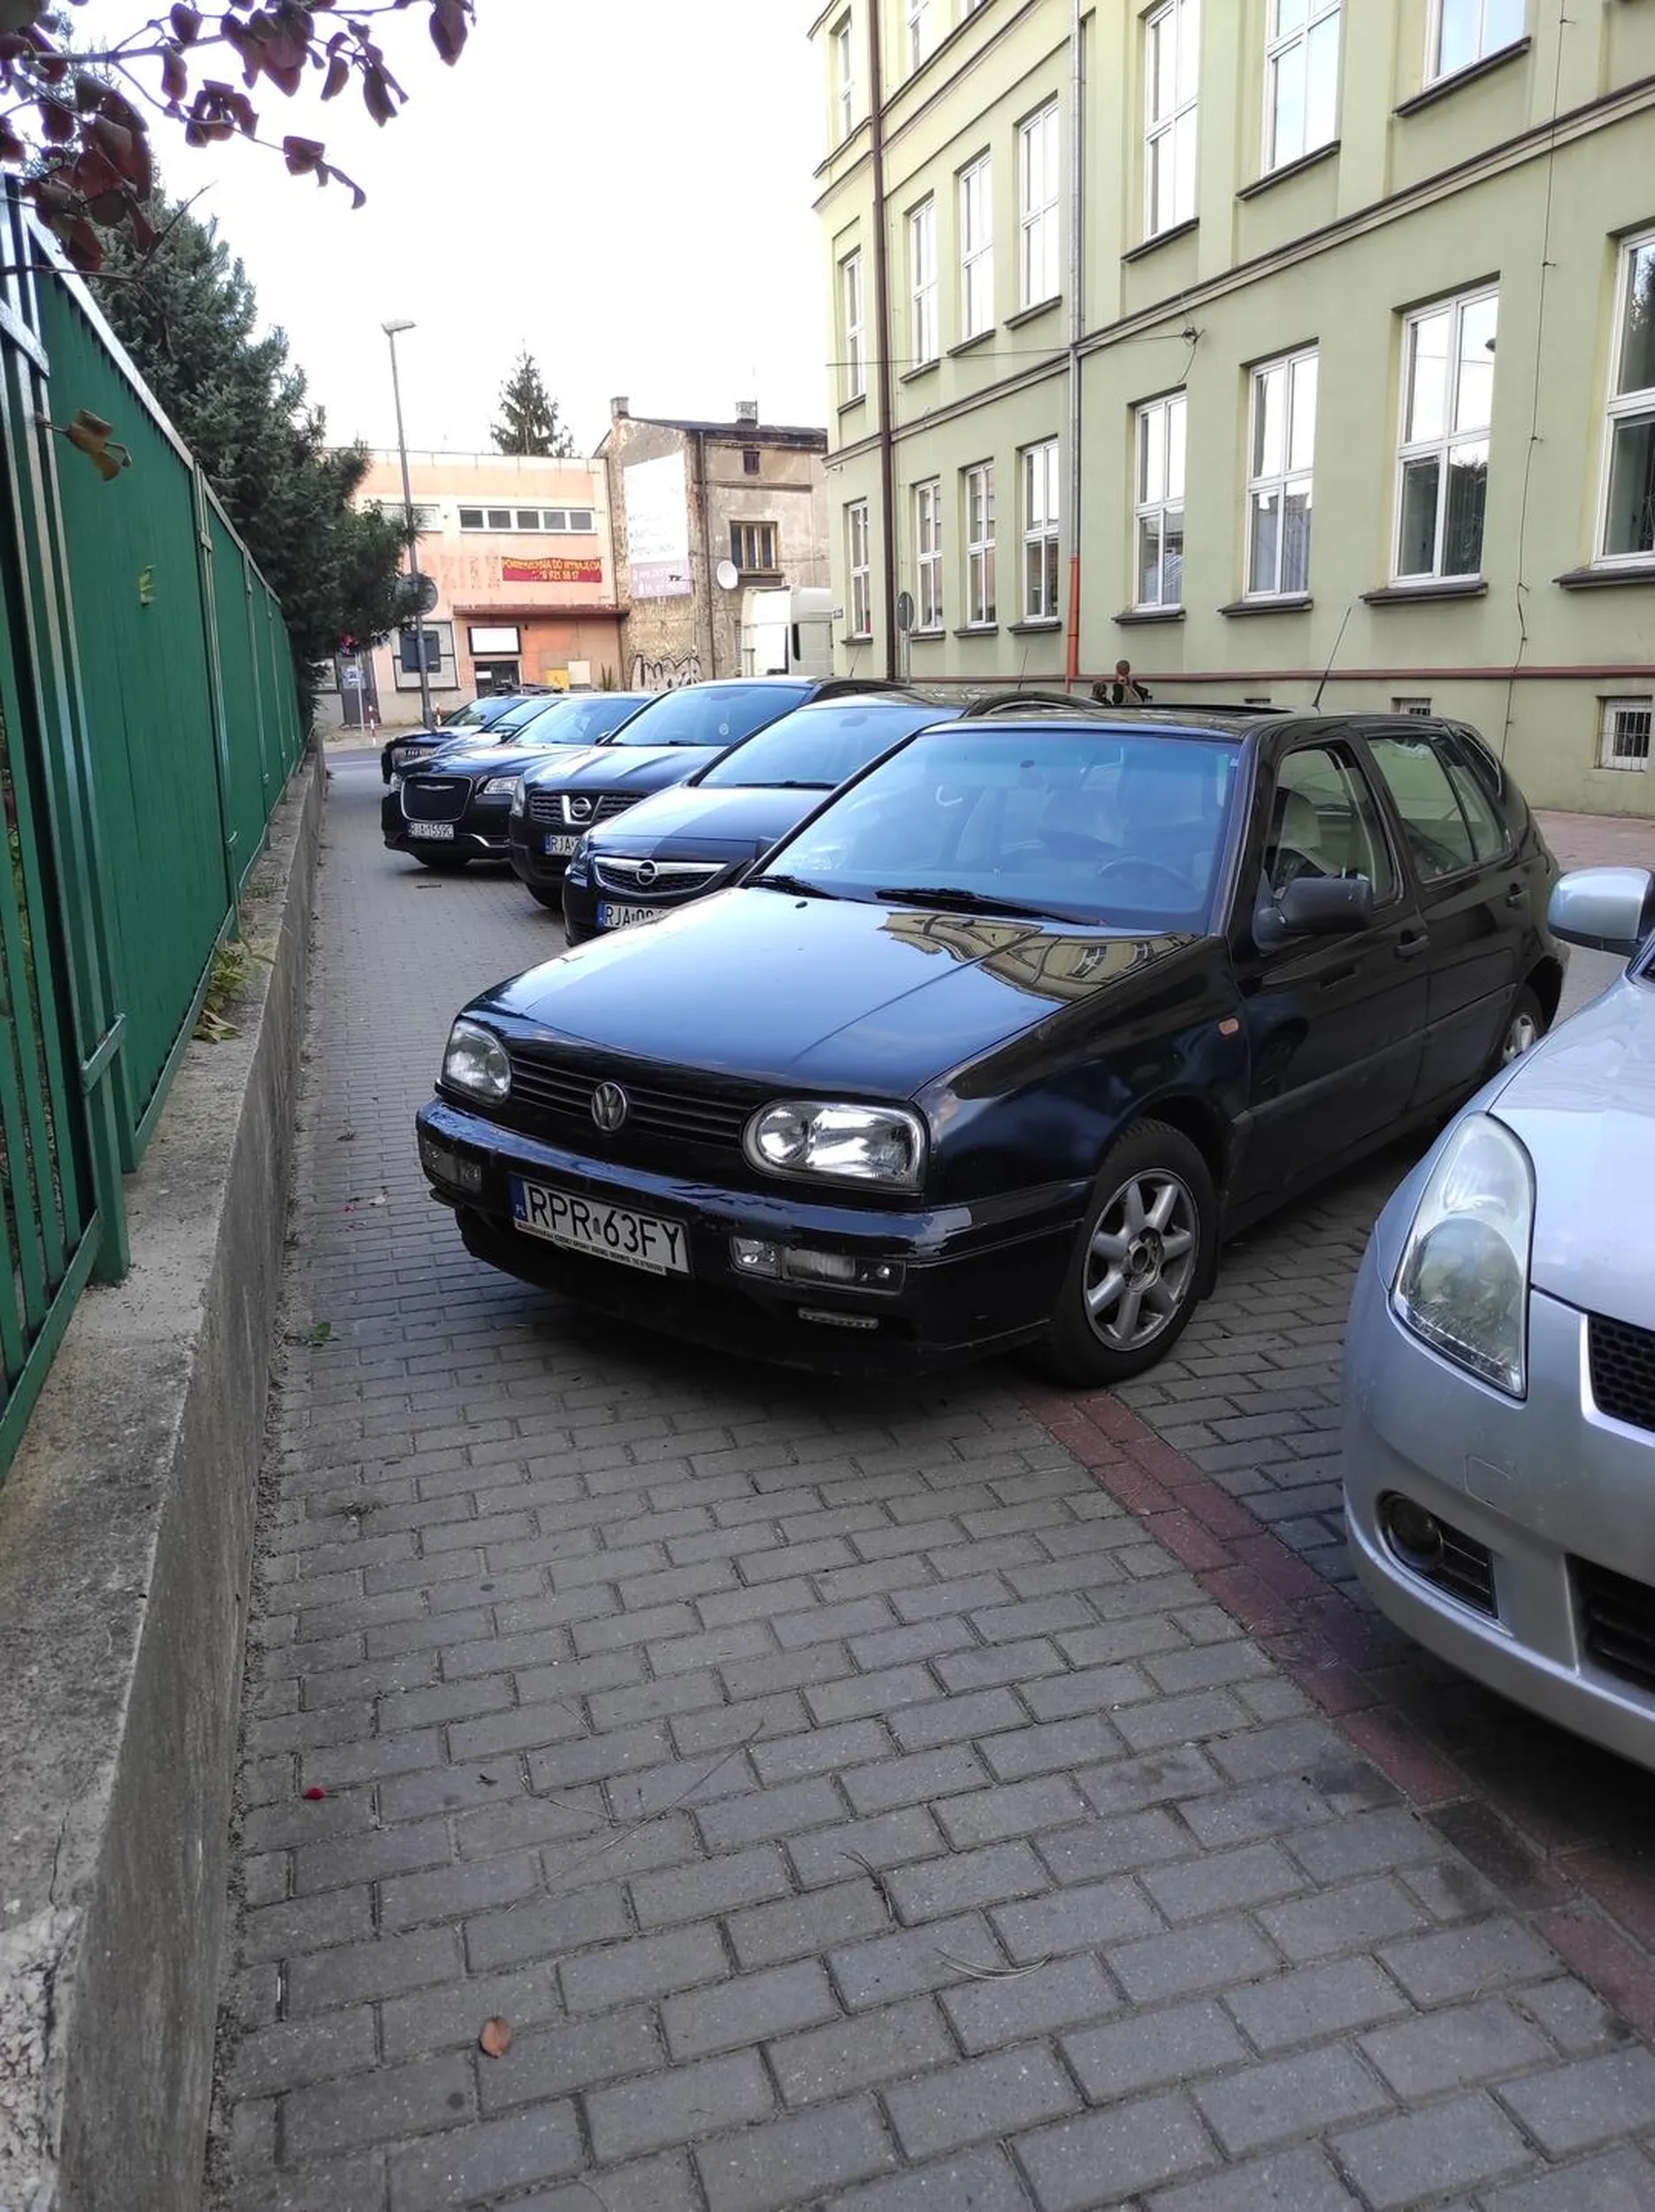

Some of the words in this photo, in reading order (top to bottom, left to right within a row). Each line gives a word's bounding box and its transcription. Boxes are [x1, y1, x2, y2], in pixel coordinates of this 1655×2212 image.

[551, 836, 571, 851] RJA
[605, 906, 630, 926] RJA
[528, 1186, 593, 1240] RPR
[603, 1210, 679, 1264] 63FY
